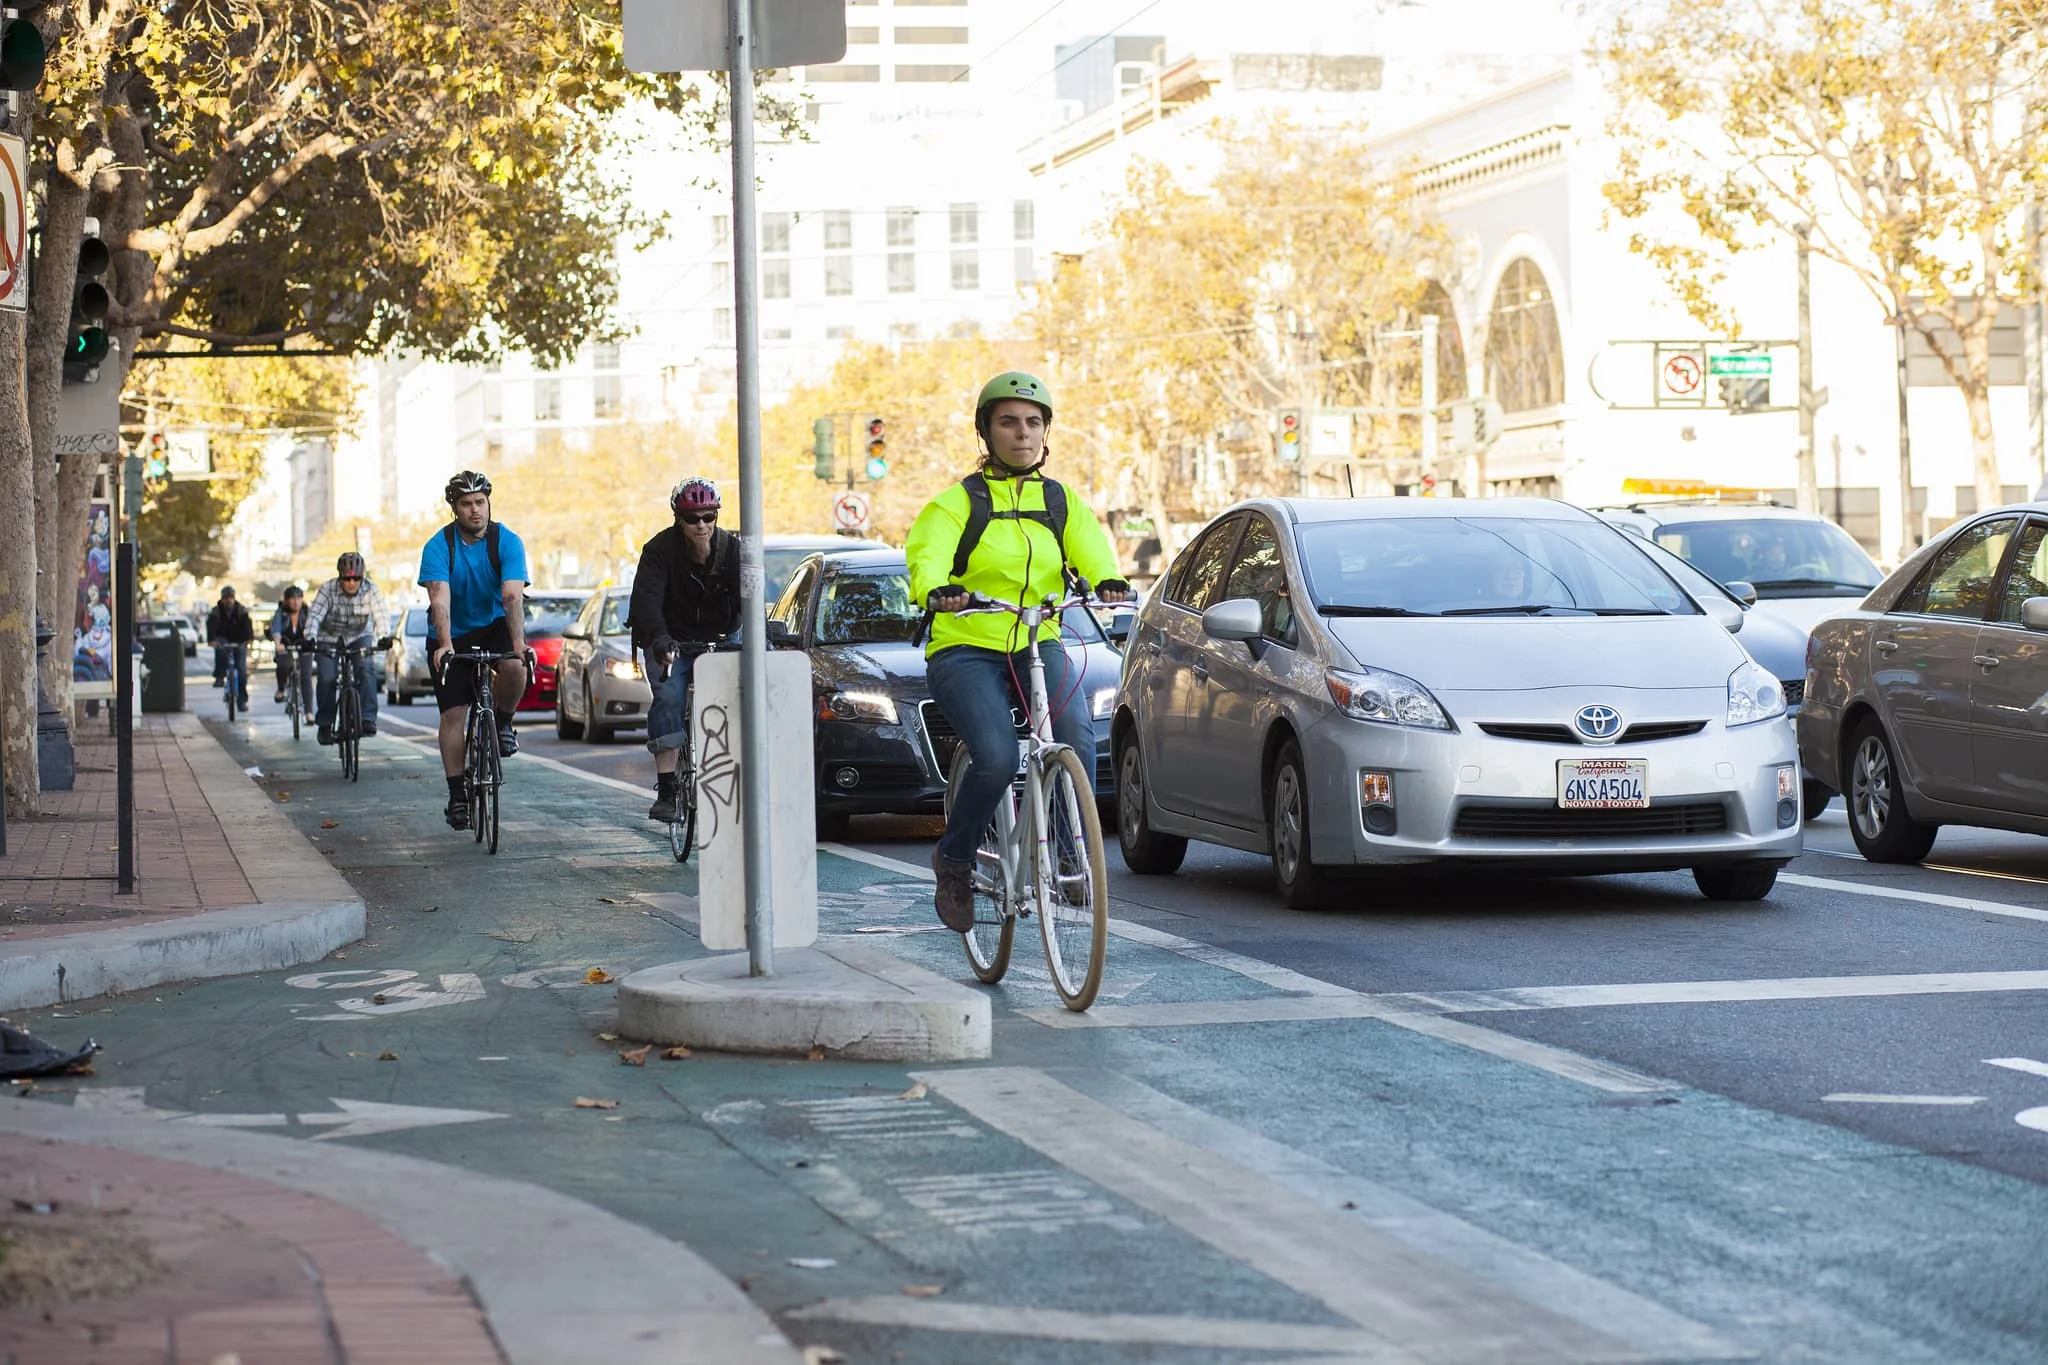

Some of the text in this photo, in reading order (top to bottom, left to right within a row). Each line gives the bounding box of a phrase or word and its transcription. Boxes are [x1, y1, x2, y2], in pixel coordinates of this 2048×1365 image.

[1577, 768, 1631, 778] California
[1565, 779, 1642, 800] 6NSA504
[1565, 800, 1643, 808] NOVATO TOYOTA
